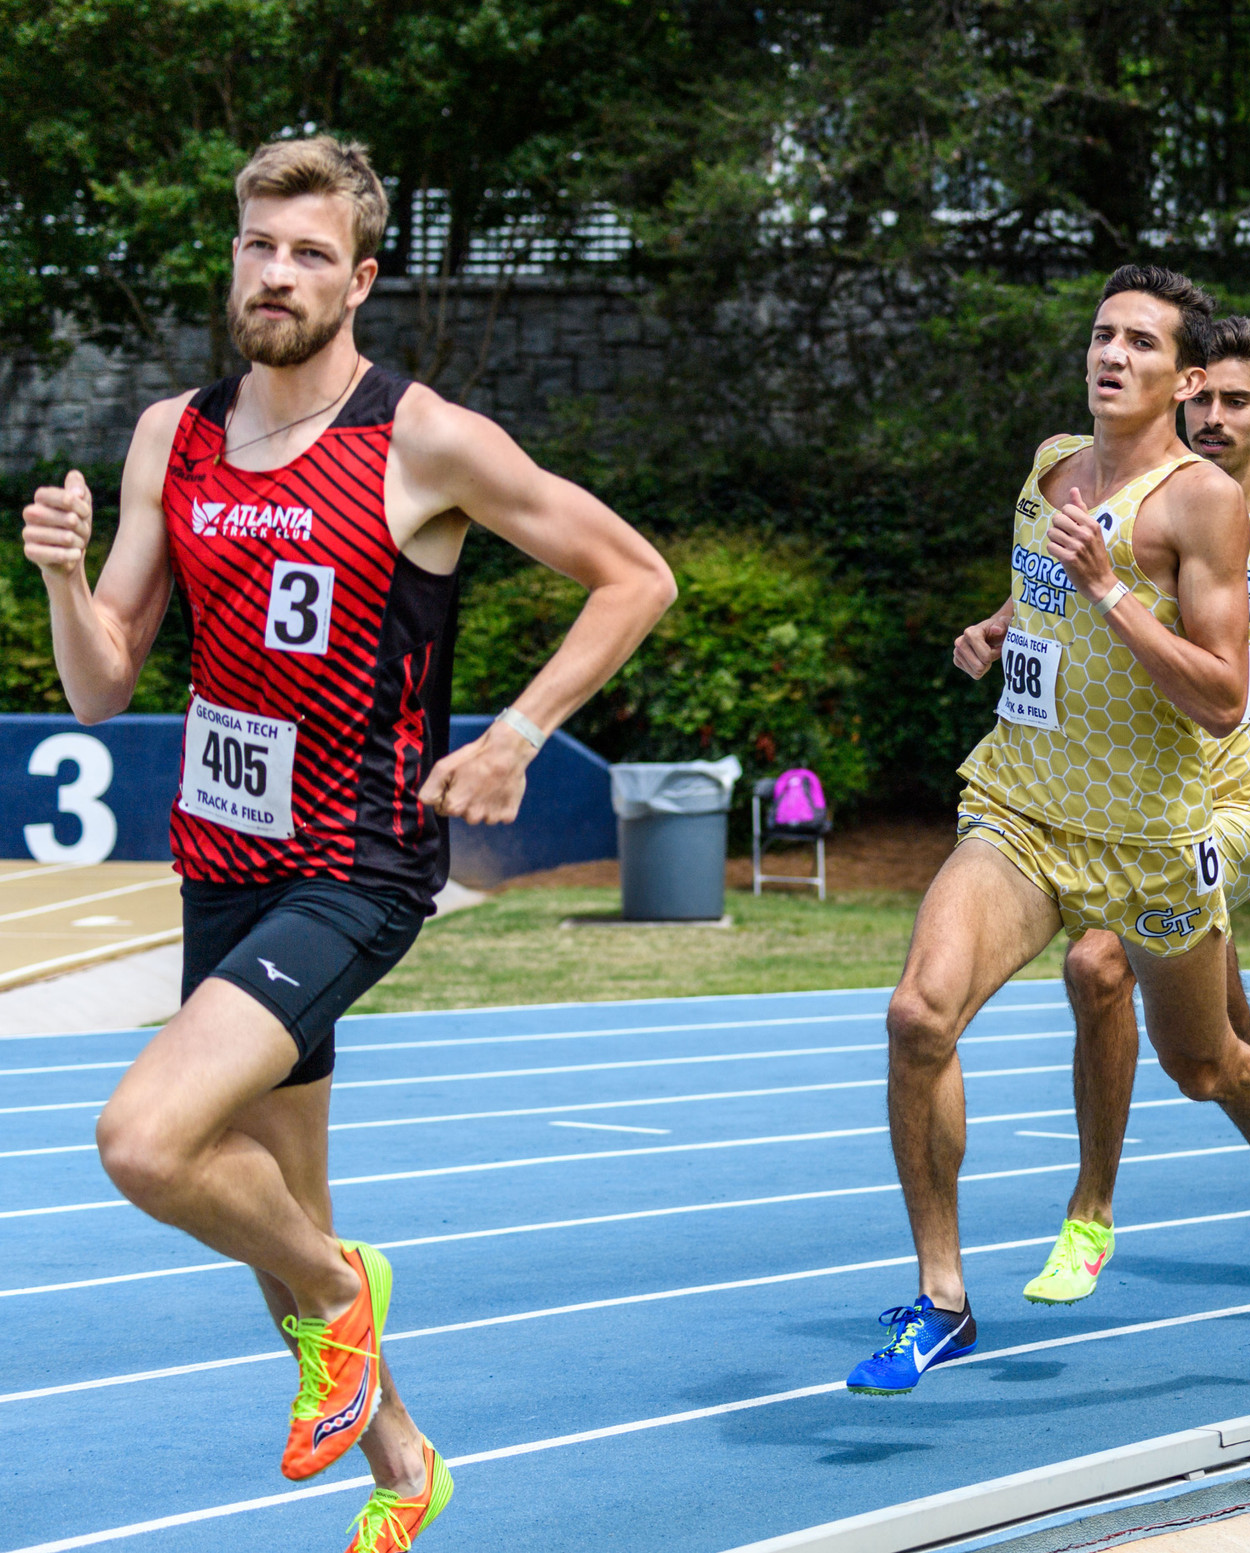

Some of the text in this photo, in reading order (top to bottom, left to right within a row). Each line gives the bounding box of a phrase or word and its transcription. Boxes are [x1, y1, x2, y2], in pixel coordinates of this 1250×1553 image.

[223, 504, 313, 530] ATLANTA
[1016, 497, 1040, 518] ACC
[222, 526, 311, 542] TRACK CLUB
[274, 570, 320, 646] 3
[1020, 576, 1067, 618] TECH
[1006, 632, 1048, 654] EORGIA TECH
[1006, 649, 1042, 699] 498
[196, 704, 278, 739] GEORGIA TECH
[1018, 704, 1024, 715] &
[1028, 706, 1048, 720] FIELD
[202, 729, 269, 798] 405
[23, 732, 118, 865] 3
[196, 788, 228, 813] TRACK
[230, 803, 238, 816] &
[242, 806, 274, 825] FIELD
[1199, 836, 1218, 886] 6
